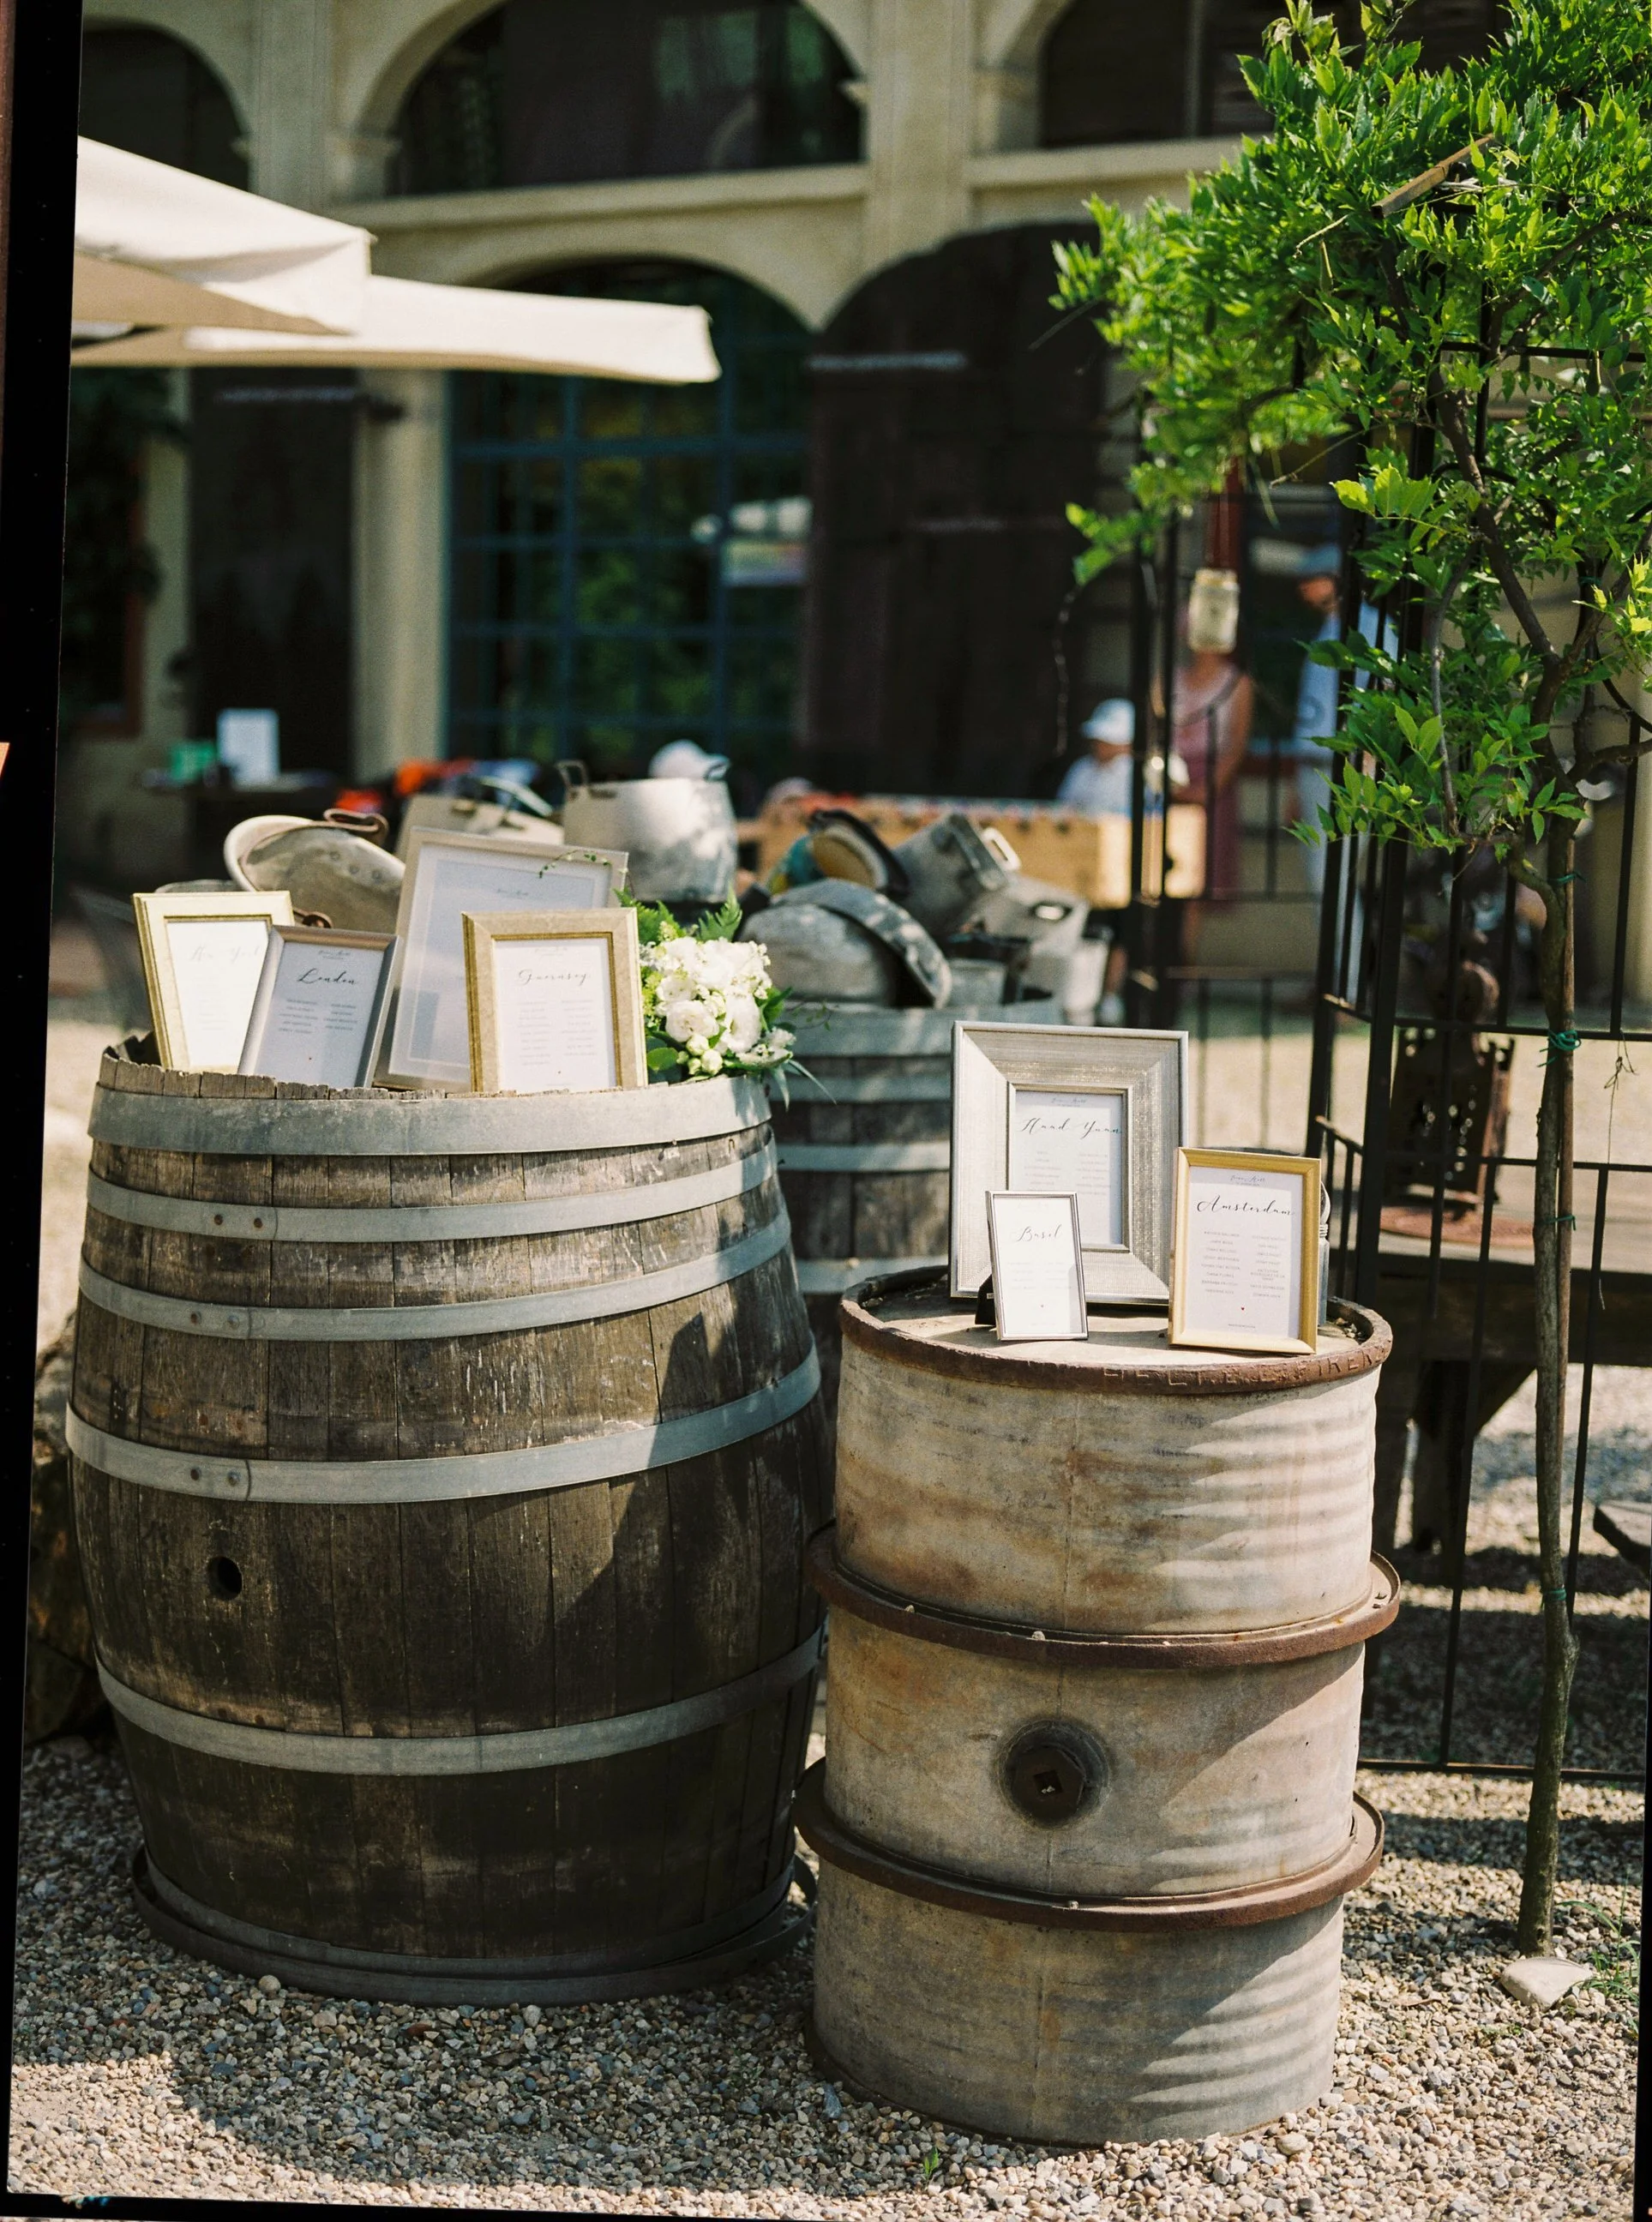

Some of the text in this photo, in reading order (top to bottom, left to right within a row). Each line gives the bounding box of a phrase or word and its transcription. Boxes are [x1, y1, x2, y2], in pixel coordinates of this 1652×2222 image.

[297, 968, 357, 985] London
[517, 968, 589, 987] Guernsey
[1197, 1194, 1295, 1216] Amsterdam
[1017, 1224, 1063, 1242] Basel
